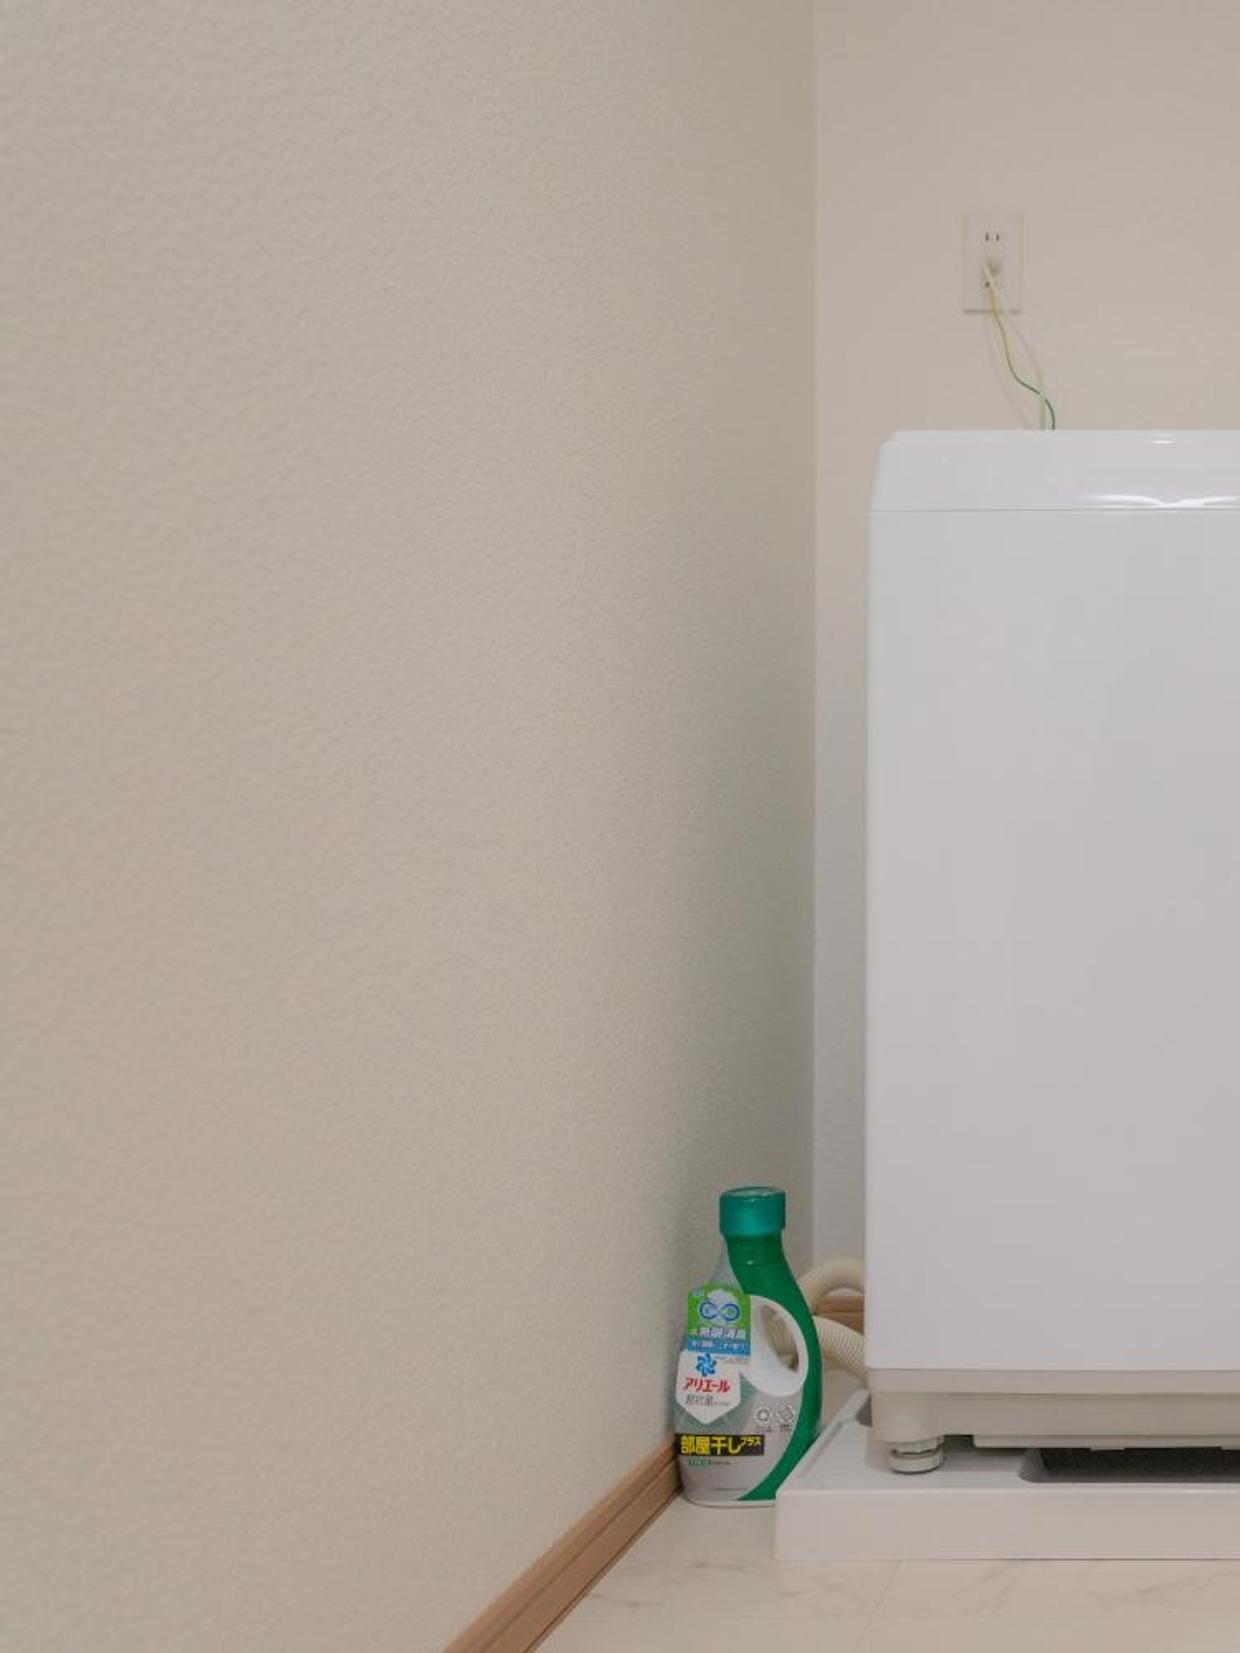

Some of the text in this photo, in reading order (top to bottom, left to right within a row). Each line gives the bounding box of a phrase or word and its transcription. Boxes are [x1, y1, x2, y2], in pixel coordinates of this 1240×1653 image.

[682, 1377, 730, 1393] アリエール
[680, 1434, 762, 1455] 部屋干しプラス
